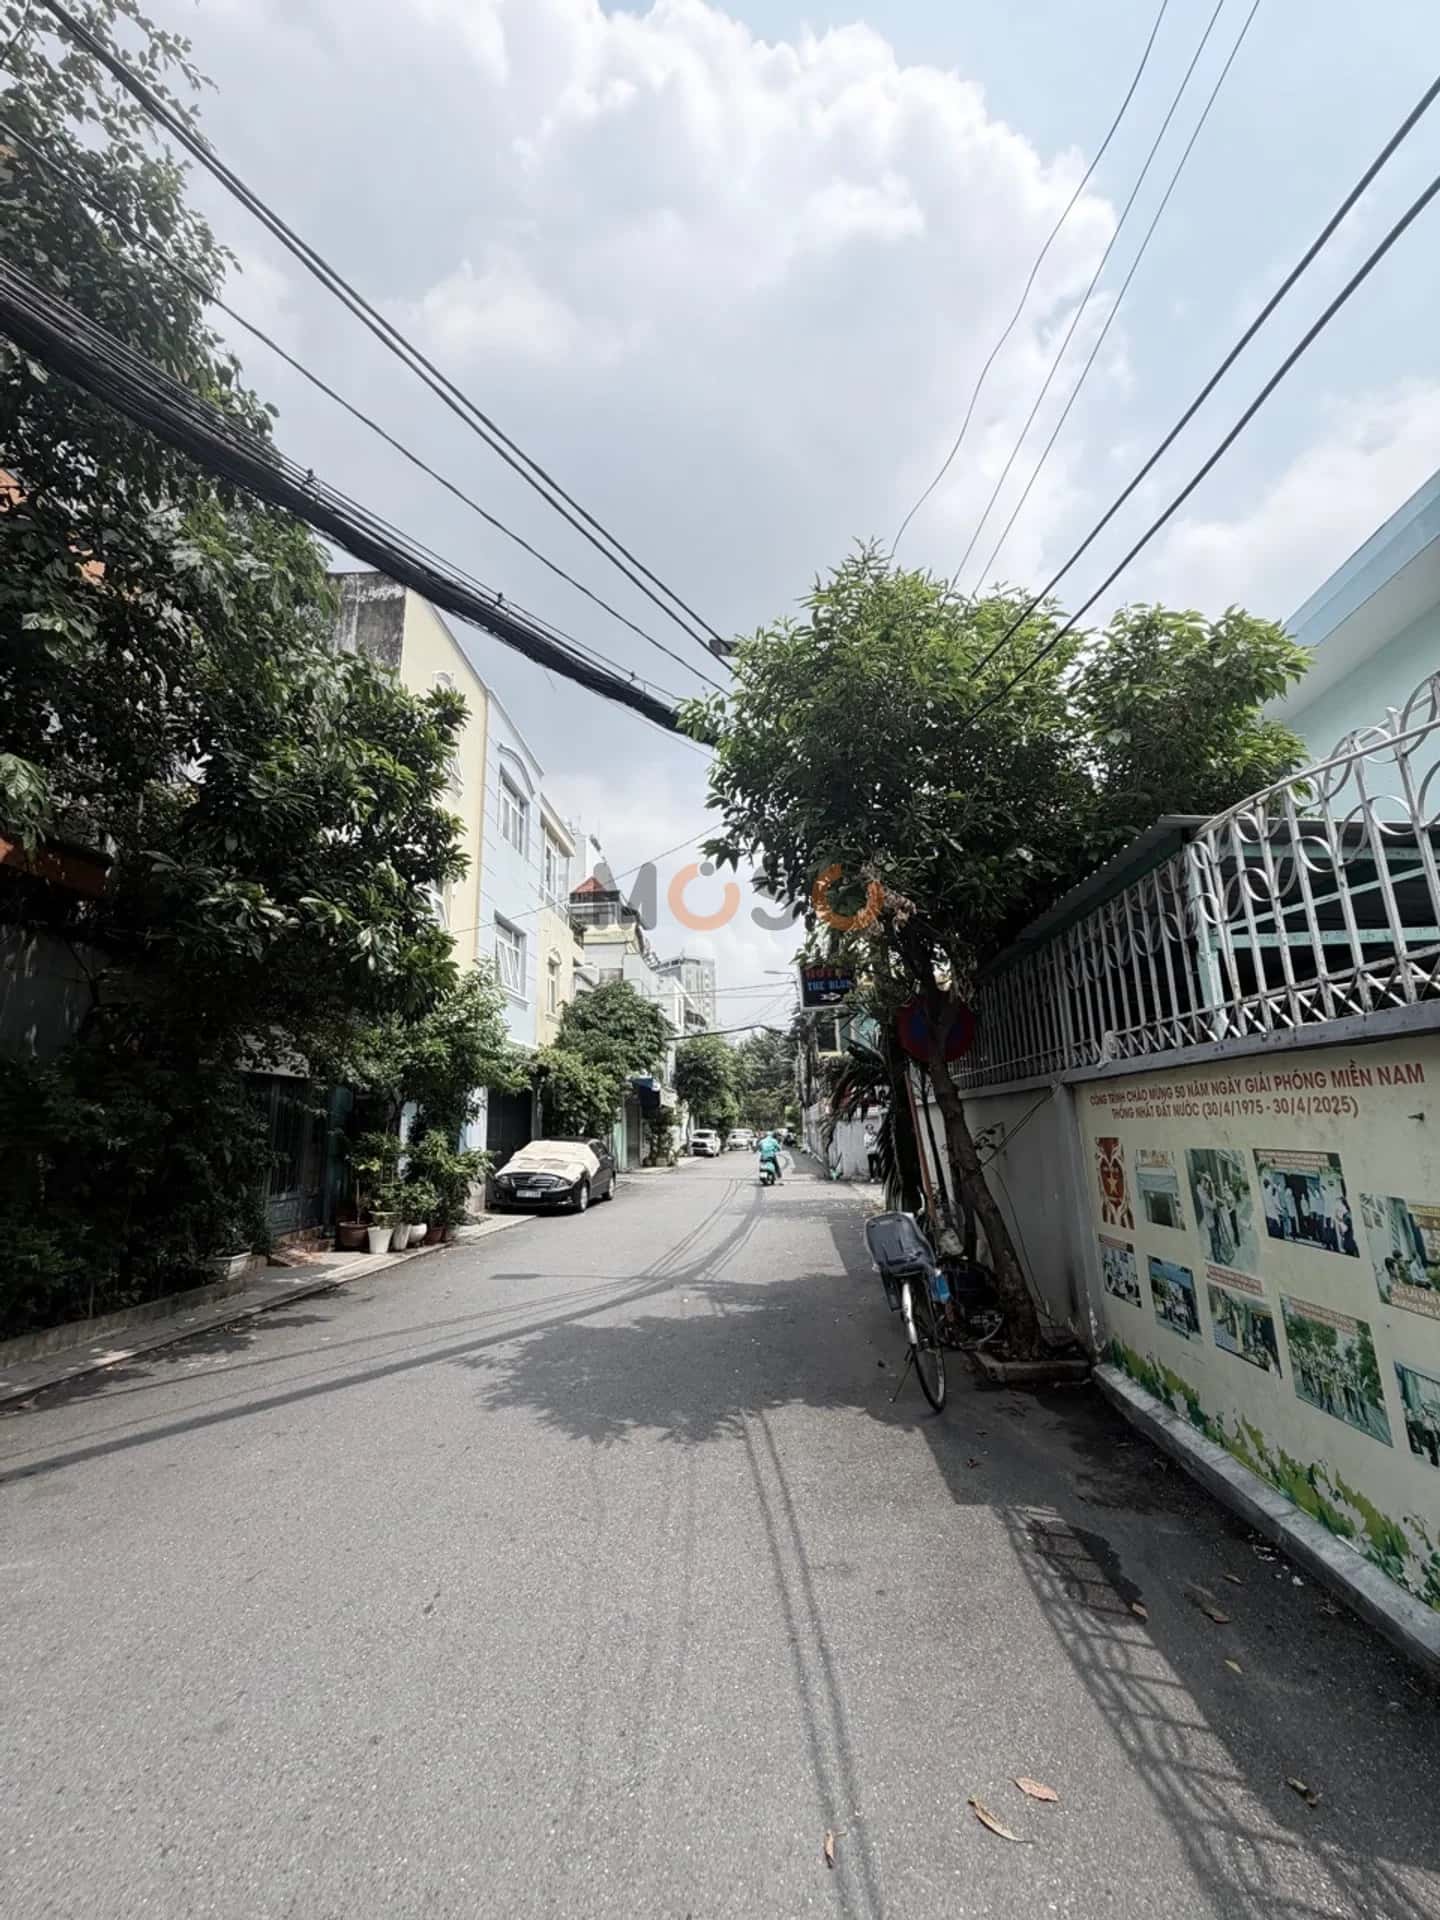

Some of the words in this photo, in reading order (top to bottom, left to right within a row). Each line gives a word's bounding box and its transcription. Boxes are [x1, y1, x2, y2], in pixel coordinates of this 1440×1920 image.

[1175, 1085, 1185, 1098] 50
[1187, 1079, 1209, 1097] NĂM
[1211, 1075, 1241, 1097] NGÀY
[1245, 1070, 1272, 1093] GIẢI
[1274, 1067, 1327, 1091] PHÓNG
[1330, 1058, 1374, 1089] MIỀN
[1376, 1062, 1425, 1087] NAM
[1202, 1098, 1264, 1120] (30/4/1975
[1273, 1095, 1359, 1119] 30/4/2025)
